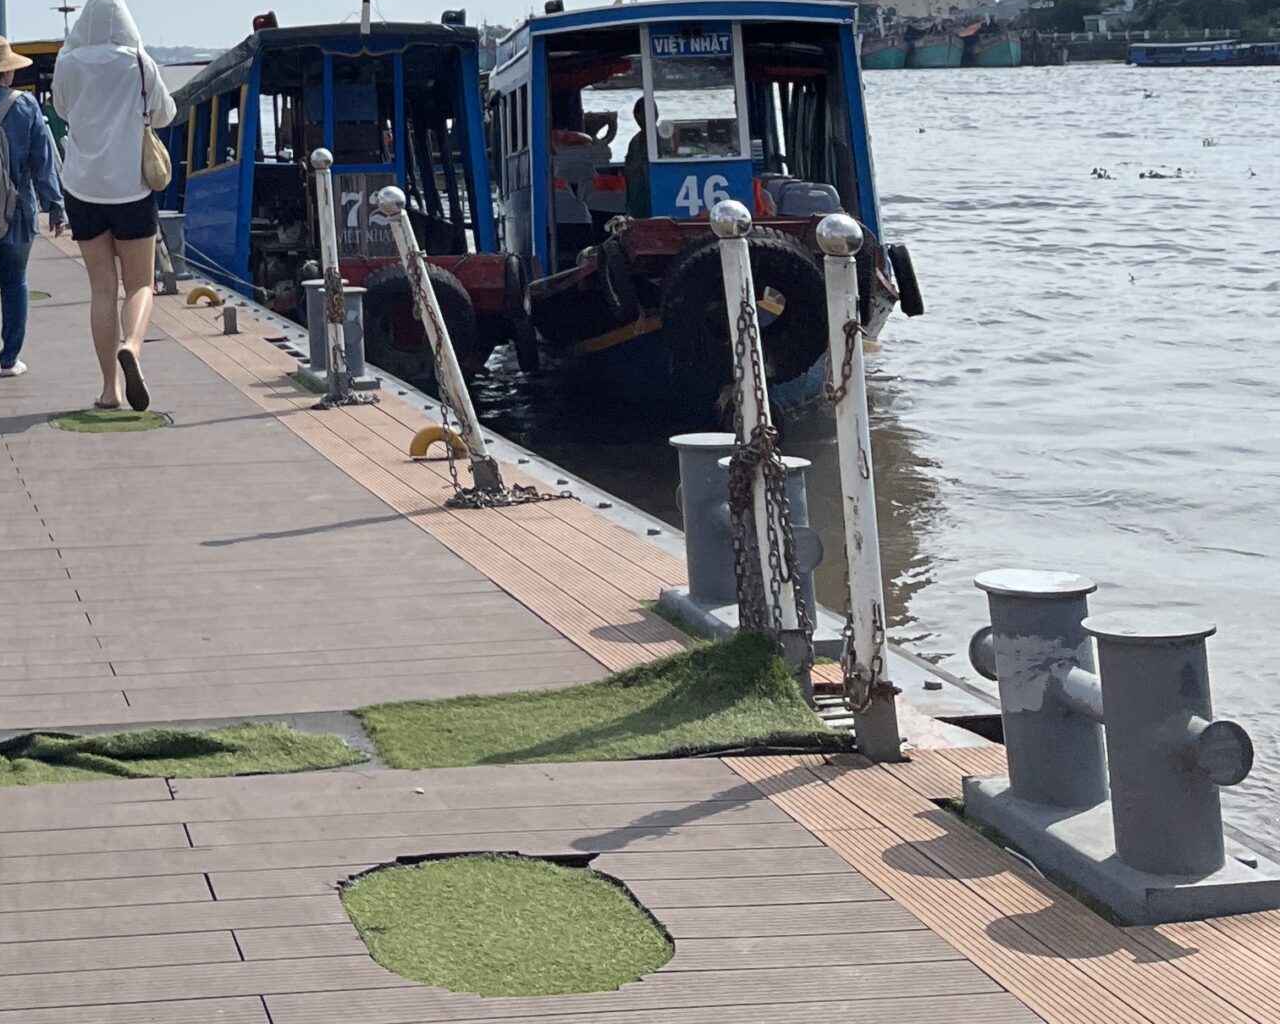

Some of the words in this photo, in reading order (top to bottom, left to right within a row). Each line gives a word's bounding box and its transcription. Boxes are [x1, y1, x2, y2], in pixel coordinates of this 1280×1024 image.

[654, 35, 686, 55] VIỆT
[690, 33, 729, 53] NHẬT
[675, 175, 732, 216] 46
